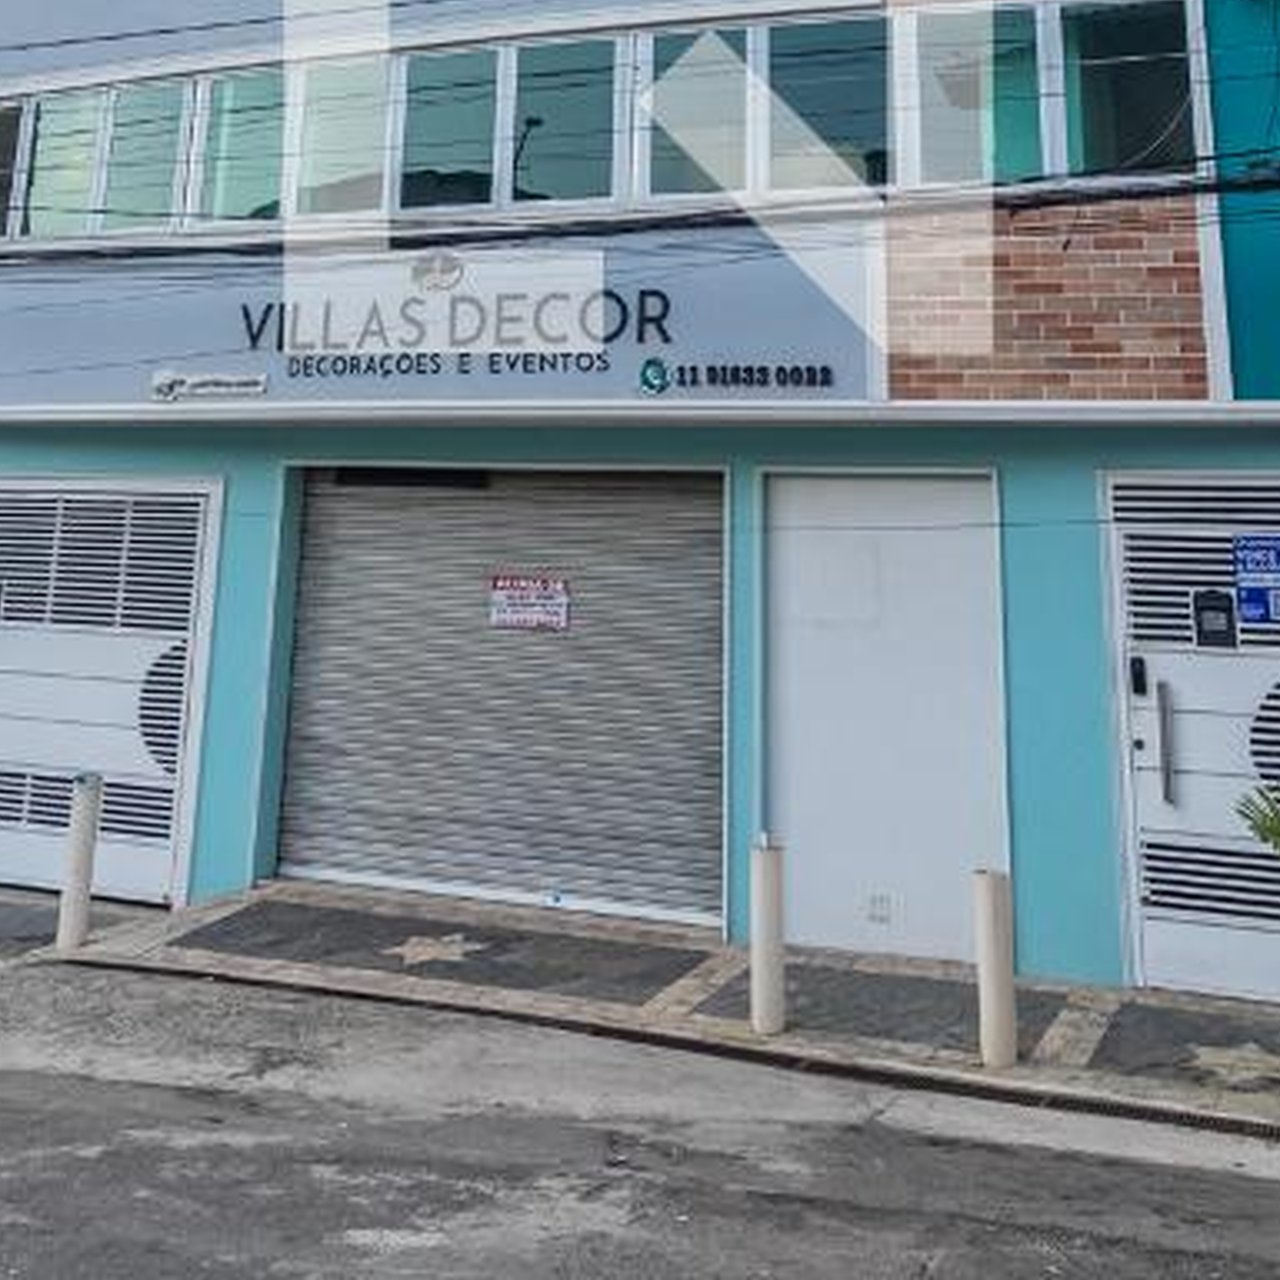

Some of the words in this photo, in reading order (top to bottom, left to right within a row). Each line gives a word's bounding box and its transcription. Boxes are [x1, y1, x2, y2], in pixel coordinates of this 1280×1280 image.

[241, 298, 427, 352] VILLAS
[448, 289, 673, 348] DECOR
[458, 353, 471, 375] E
[488, 349, 611, 375] EVENTOS
